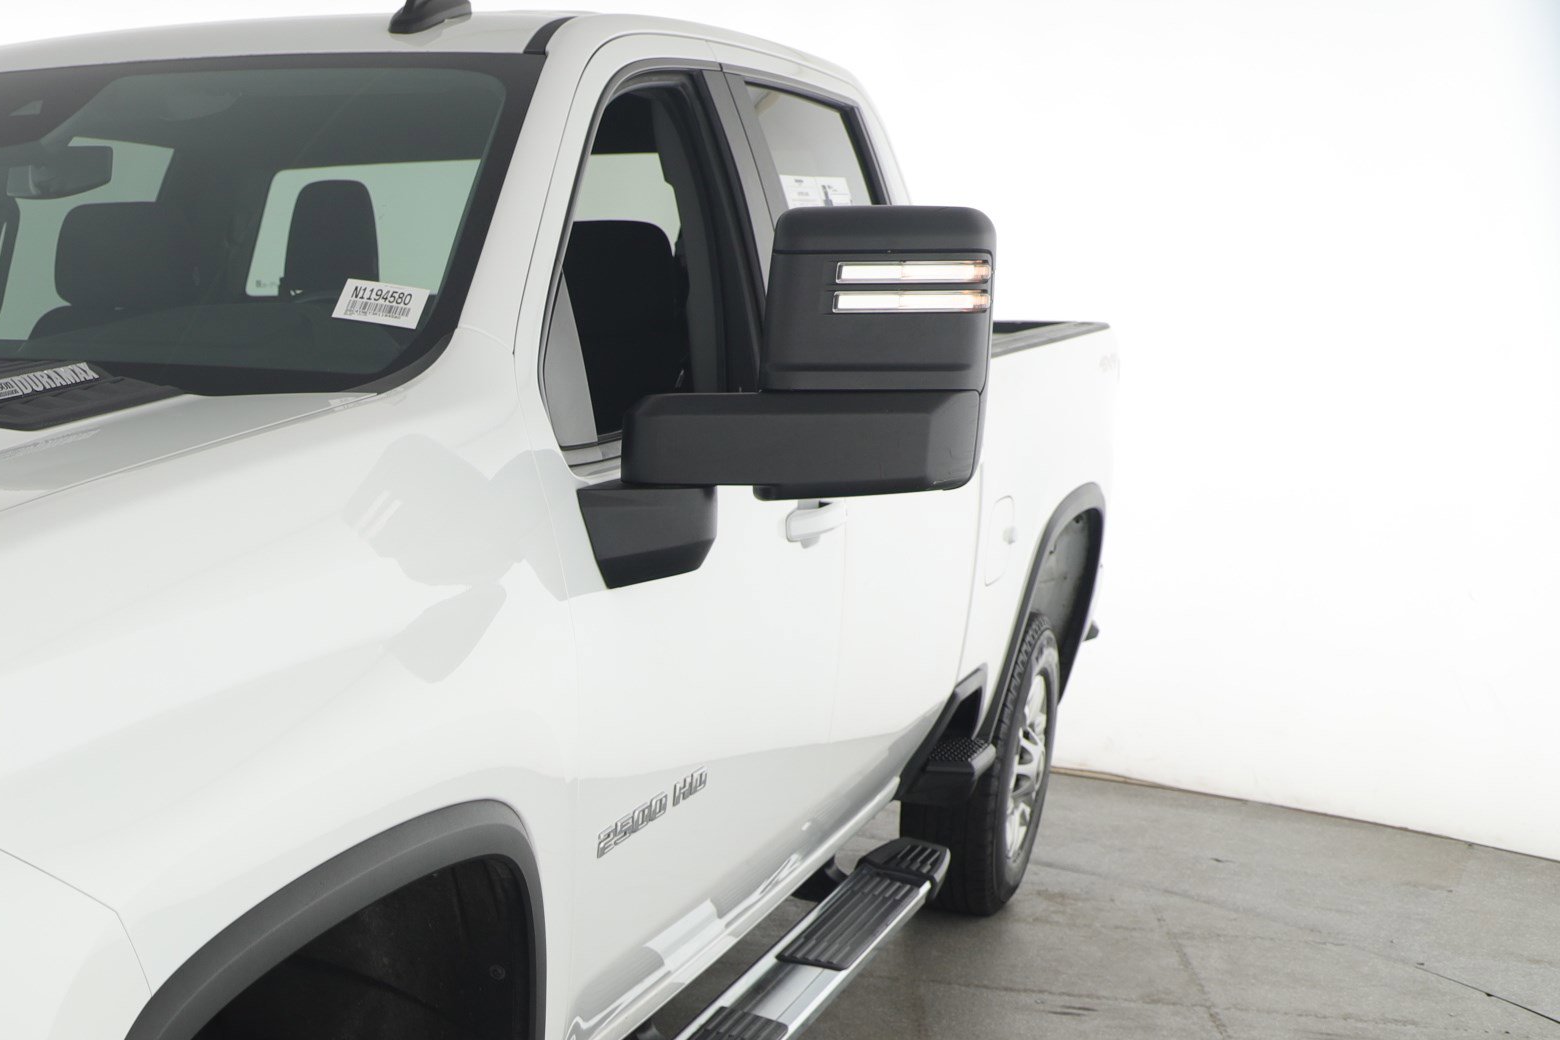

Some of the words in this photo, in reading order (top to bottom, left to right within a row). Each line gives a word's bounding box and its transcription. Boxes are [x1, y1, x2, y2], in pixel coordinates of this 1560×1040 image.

[351, 286, 413, 306] N1194580
[15, 362, 100, 394] DURAMAX
[596, 791, 668, 859] 2500
[672, 765, 708, 807] HD
